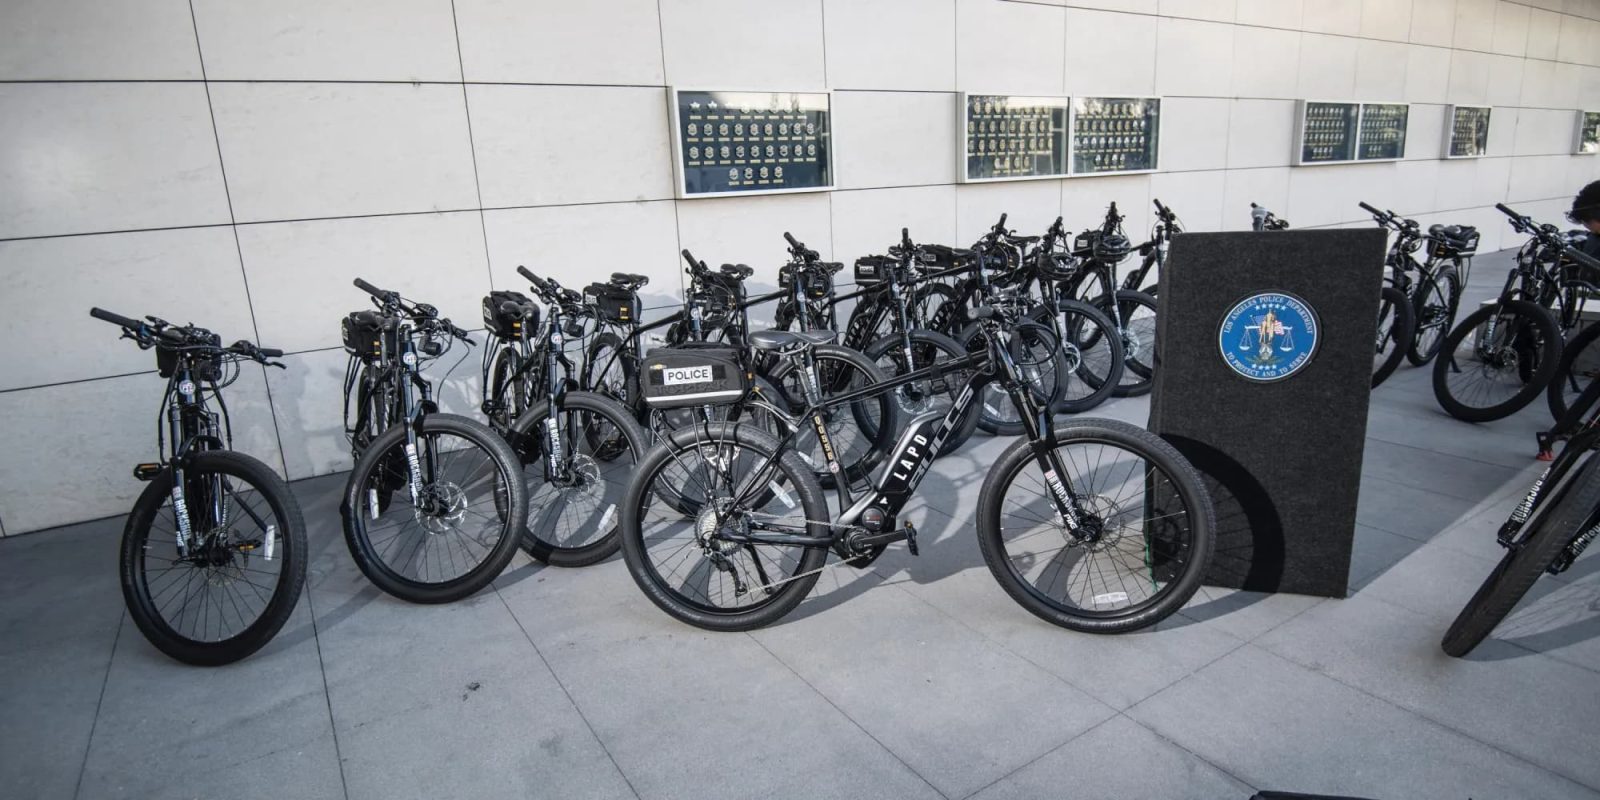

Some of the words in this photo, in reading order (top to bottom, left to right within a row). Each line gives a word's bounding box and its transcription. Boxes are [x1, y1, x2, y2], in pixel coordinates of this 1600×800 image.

[1223, 322, 1233, 334] LOS
[1231, 299, 1257, 321] ANGELES
[1259, 296, 1284, 304] POLICE
[1286, 300, 1313, 335] DEPARTMENT
[668, 369, 709, 381] POLICE
[1226, 351, 1234, 360] TO
[1232, 358, 1260, 377] PROTECT
[1279, 367, 1288, 376] TO
[1289, 351, 1308, 369] SERVE
[893, 434, 928, 481] LAPD
[1063, 513, 1079, 530] PIKE
